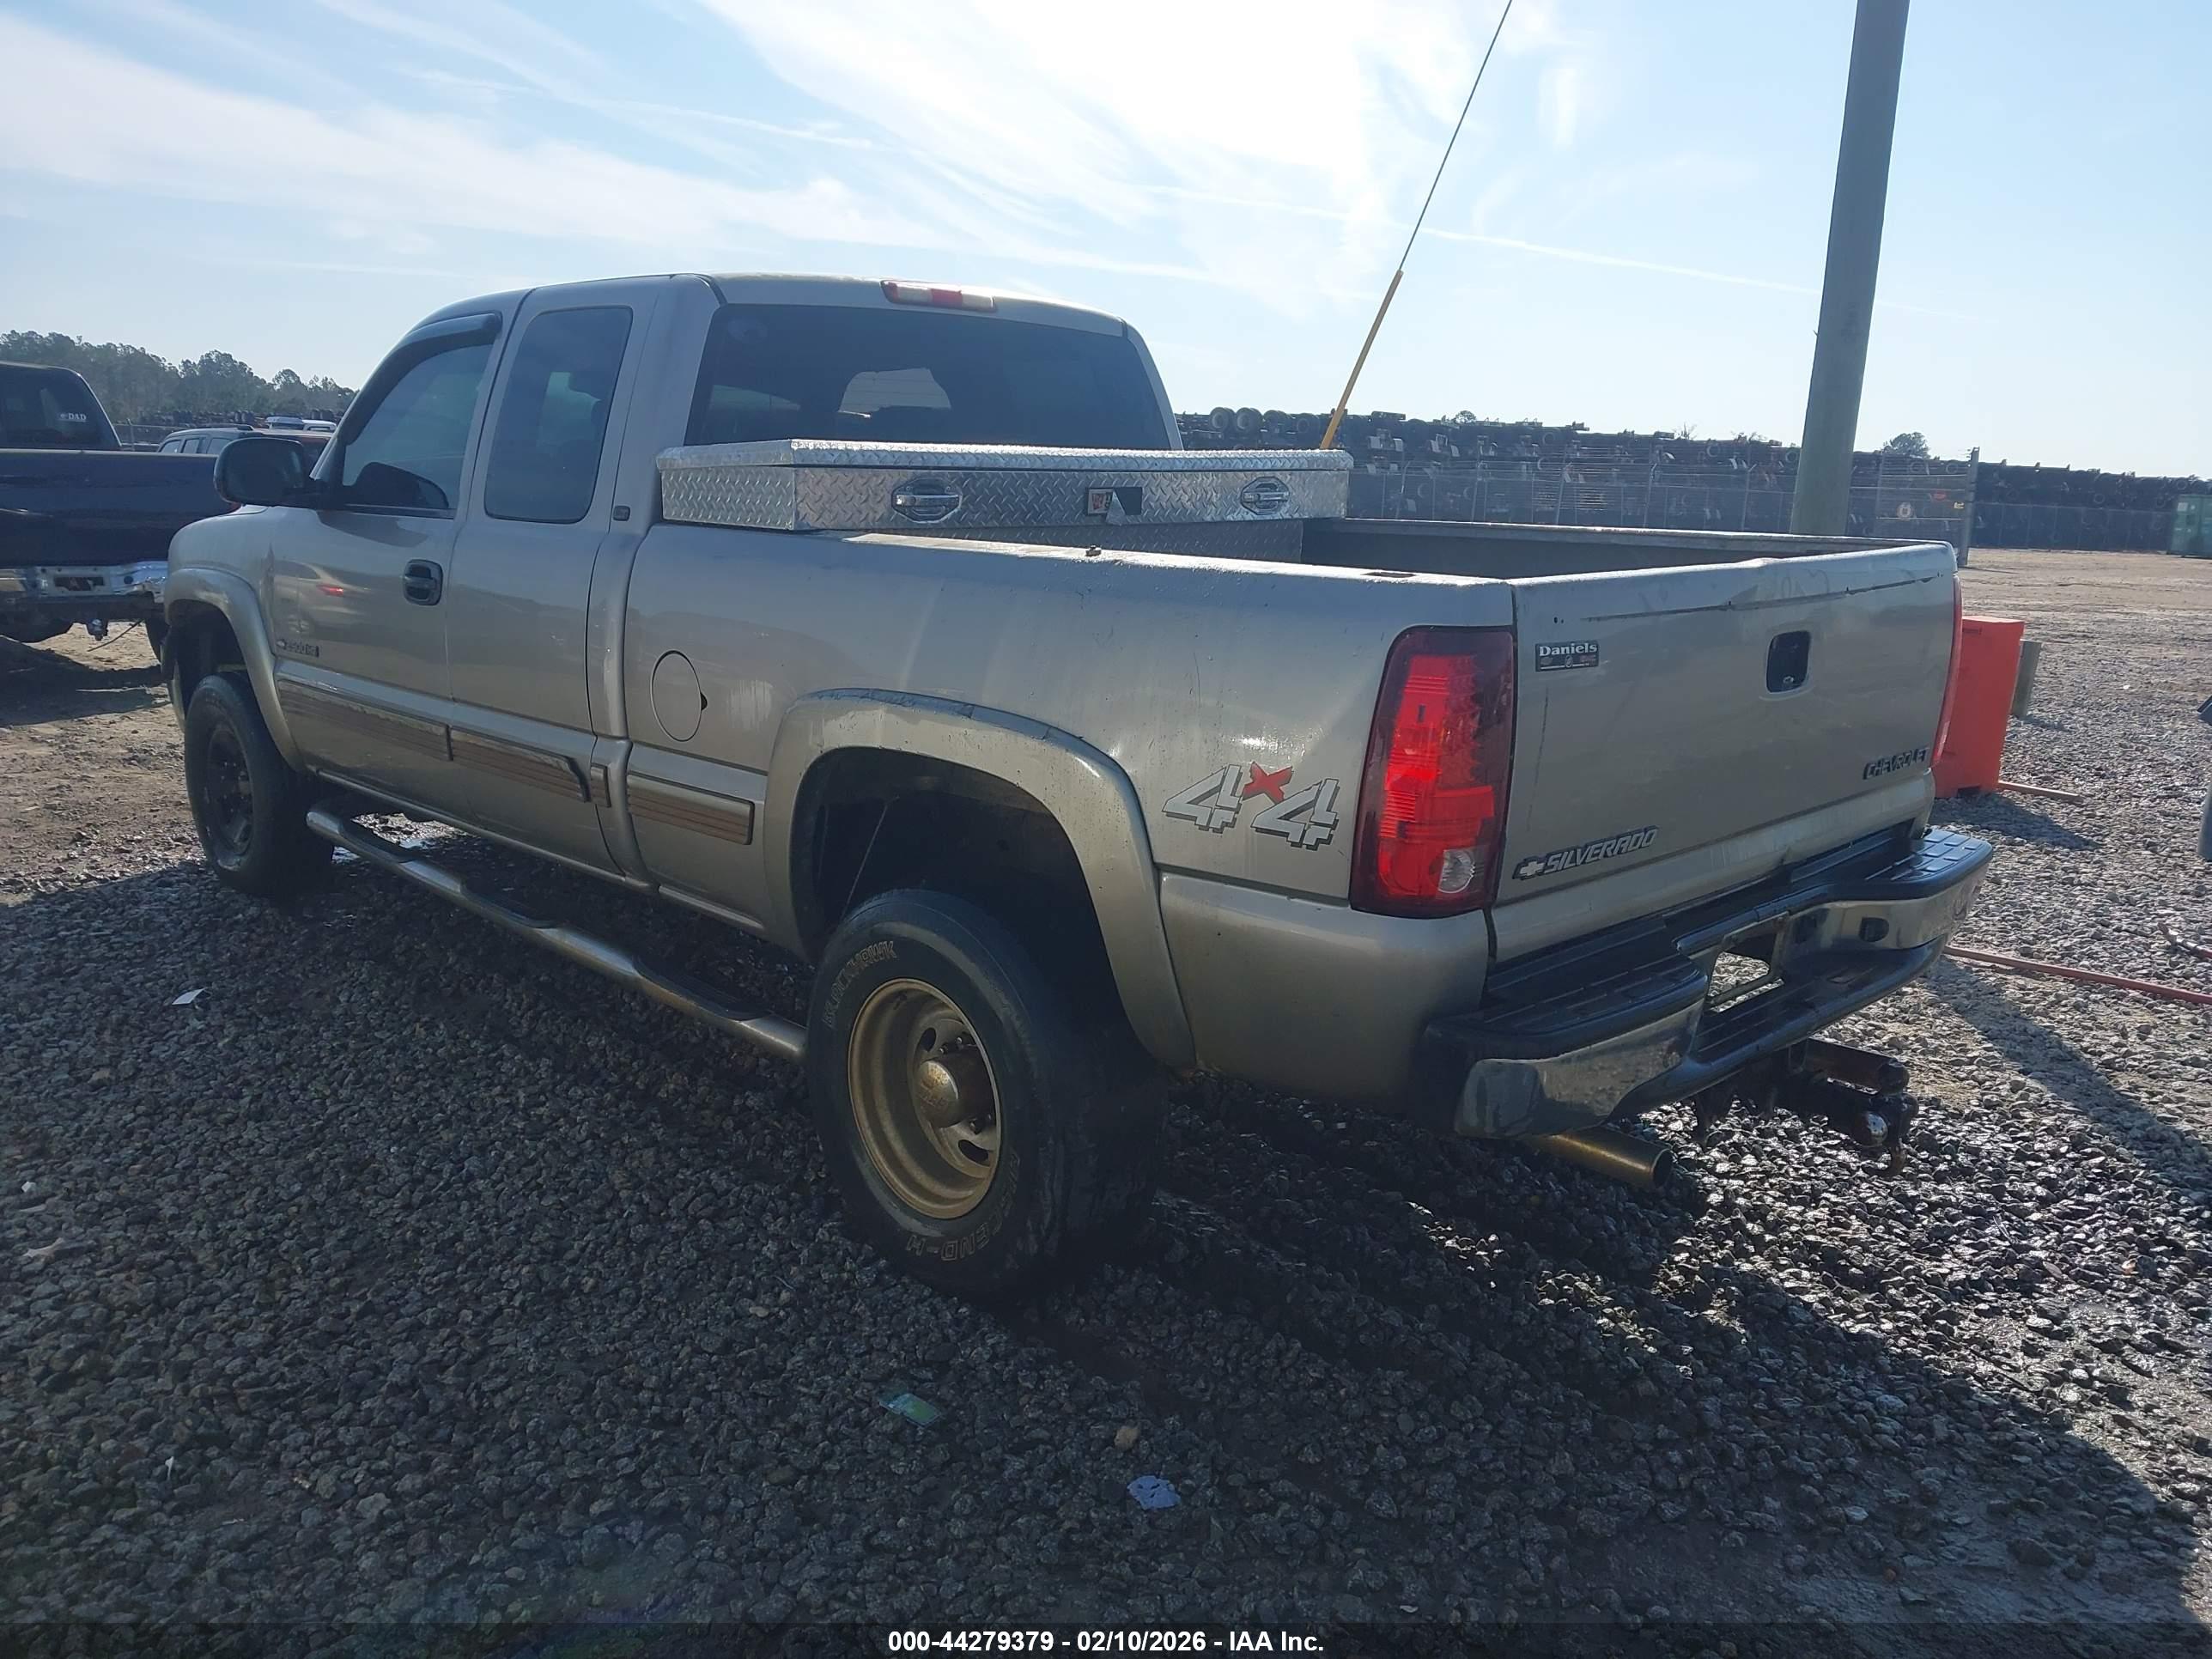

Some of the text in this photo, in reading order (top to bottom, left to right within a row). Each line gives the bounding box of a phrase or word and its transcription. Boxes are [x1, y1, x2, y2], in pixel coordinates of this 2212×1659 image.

[1539, 642, 1598, 656] Daniels
[1863, 746, 1929, 780] CHEVROLET
[1543, 826, 1659, 874] SILVERADO
